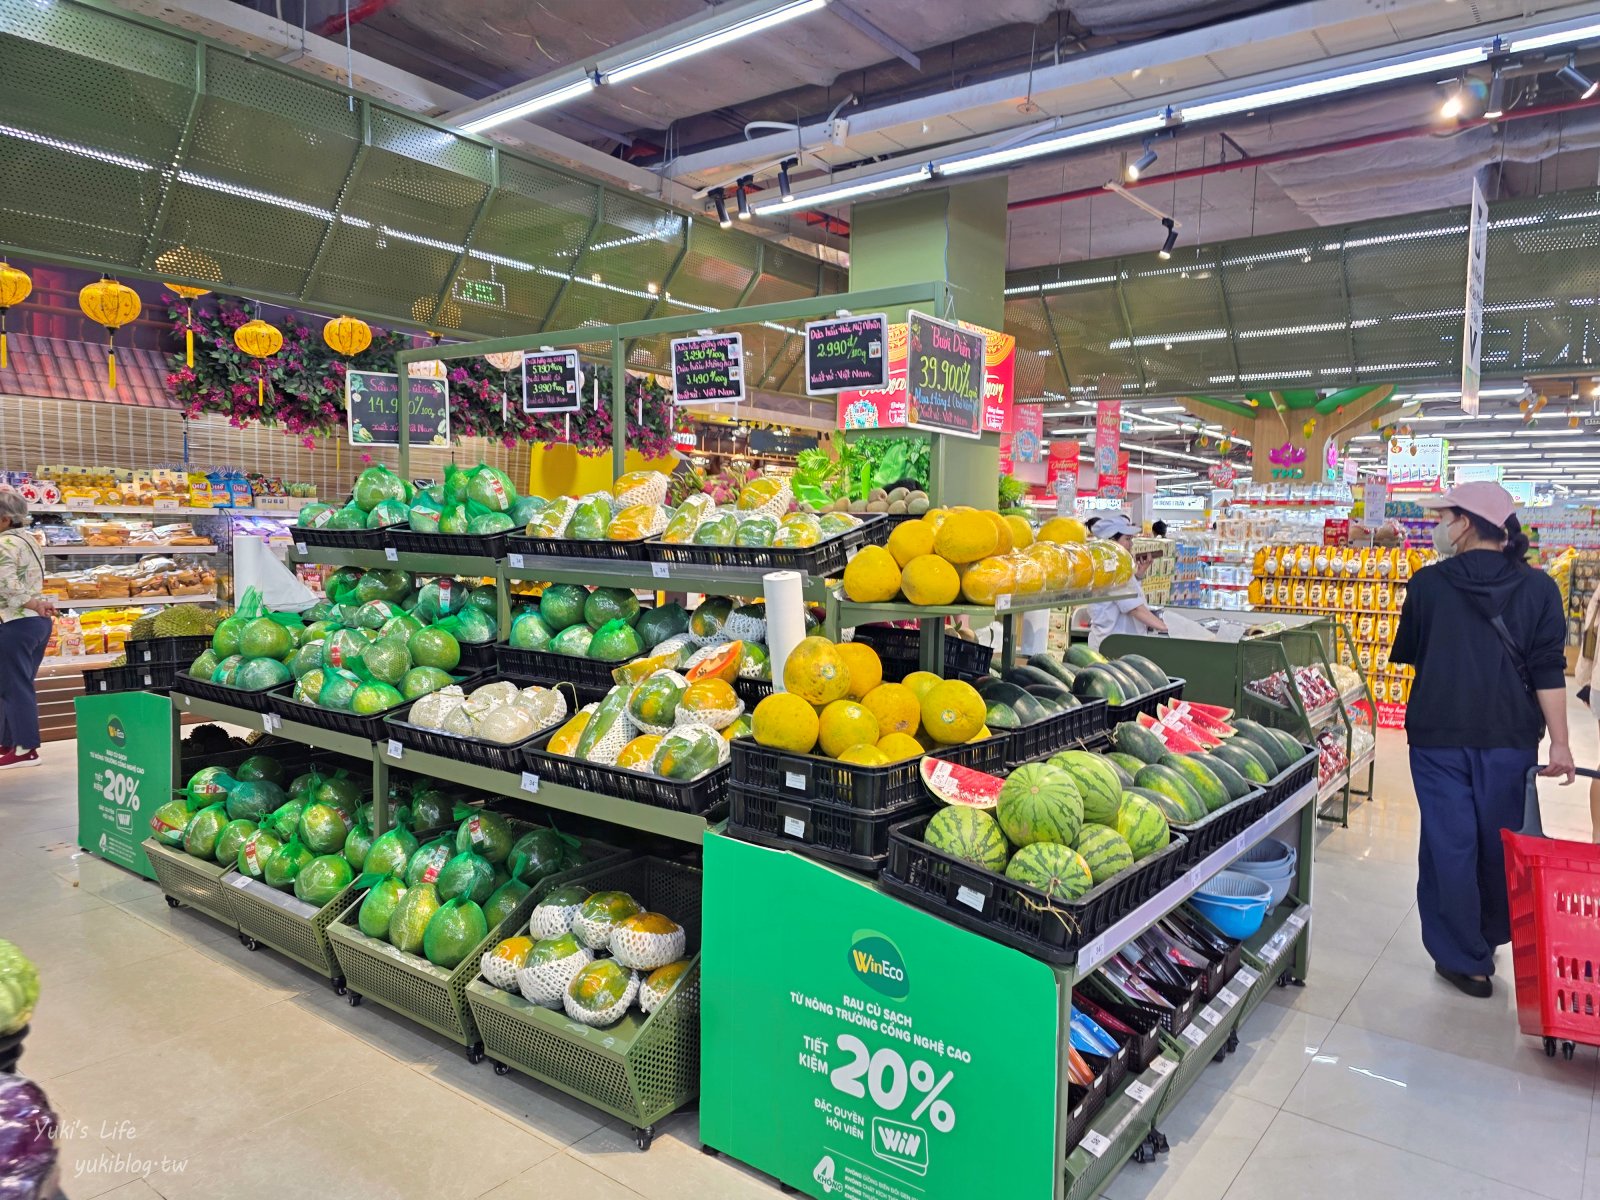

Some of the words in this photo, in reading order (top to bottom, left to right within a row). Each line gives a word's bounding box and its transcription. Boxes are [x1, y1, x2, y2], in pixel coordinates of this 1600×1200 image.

[103, 768, 140, 812] 20%
[853, 949, 904, 982] WinEco
[790, 991, 804, 1005] TỪ
[804, 996, 834, 1016] NÔNG
[835, 1007, 879, 1031] TRƯỜNG
[913, 1034, 945, 1057] NGHỆ
[946, 1045, 972, 1064] CAO
[843, 995, 865, 1011] RAU
[883, 1008, 912, 1028] SẠCH
[803, 1035, 829, 1056] TIẾT
[798, 1052, 829, 1075] KIỆM
[830, 1033, 956, 1134] 20%
[814, 1097, 833, 1113] ĐẶC
[833, 1105, 865, 1127] QUYỀN
[826, 1115, 842, 1131] HỘI
[843, 1121, 865, 1141] VIÊN
[813, 1155, 836, 1193] 4
